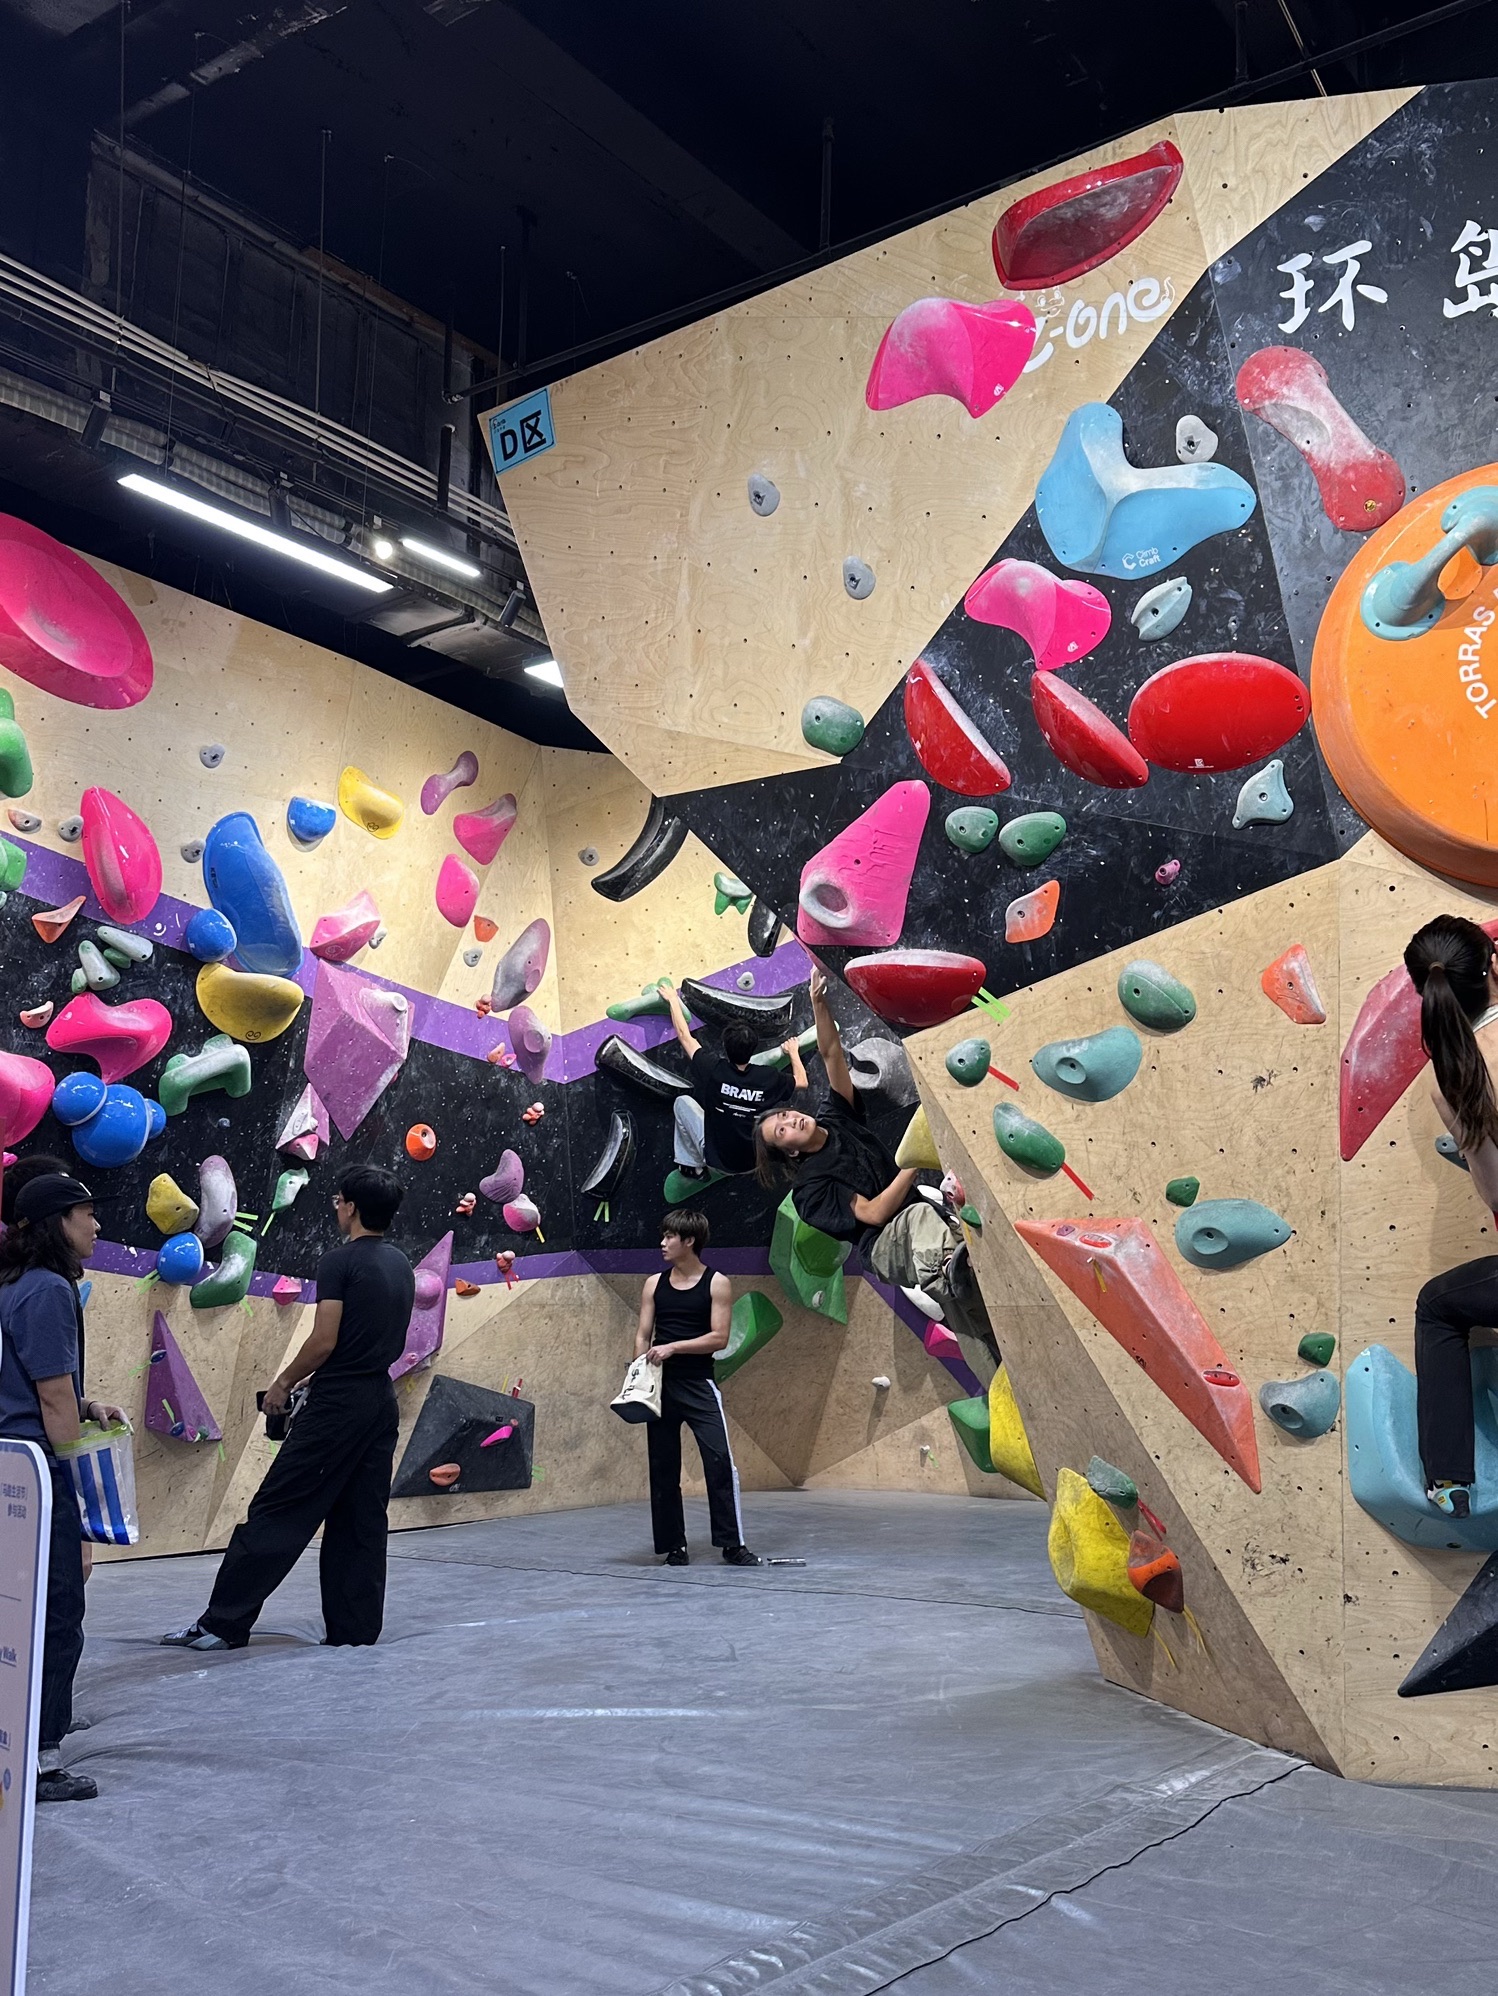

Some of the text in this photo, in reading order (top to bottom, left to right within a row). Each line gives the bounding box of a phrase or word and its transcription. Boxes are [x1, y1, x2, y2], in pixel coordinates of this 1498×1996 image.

[500, 409, 547, 461] D区
[1136, 547, 1159, 559] Climb
[1139, 554, 1161, 568] Craft
[1457, 606, 1497, 720] TORRAS
